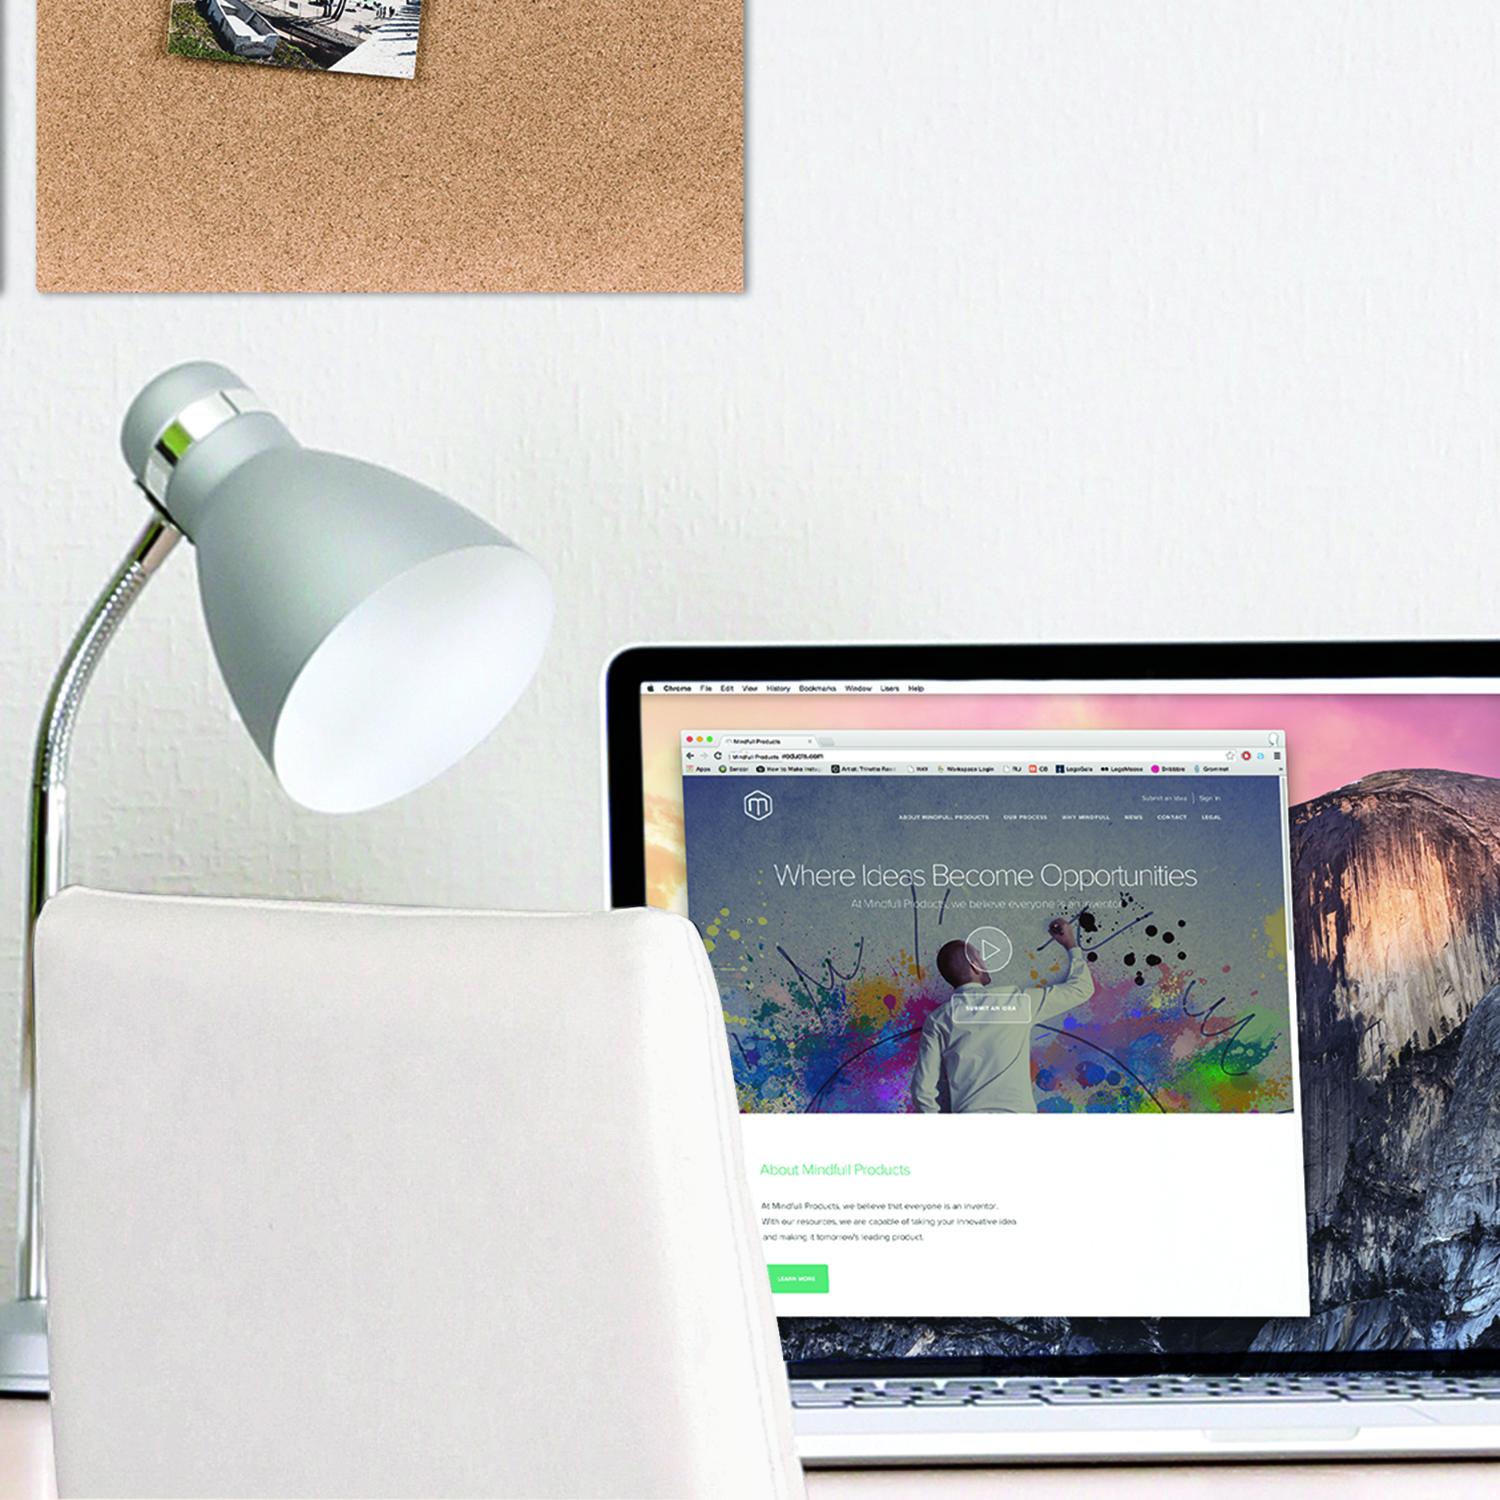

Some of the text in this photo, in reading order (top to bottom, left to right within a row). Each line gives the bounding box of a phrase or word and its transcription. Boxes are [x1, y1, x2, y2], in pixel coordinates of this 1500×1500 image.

[663, 684, 692, 692] Chrome
[700, 684, 712, 692] File
[720, 684, 734, 692] Edit
[742, 684, 758, 692] View
[766, 684, 791, 693] History
[799, 684, 837, 692] Bookmarks
[845, 684, 873, 692] Window
[908, 684, 925, 693] Help
[774, 863, 1198, 891] Where Ideas Become Opportunities
[851, 900, 861, 908] At
[969, 900, 1006, 908] believe
[1008, 901, 1055, 910] everyone
[760, 1164, 910, 1176] About Mindfull Products
[868, 1218, 899, 1226] capable
[911, 1218, 935, 1226] taking
[779, 1234, 807, 1242] making
[861, 1234, 890, 1242] leading
